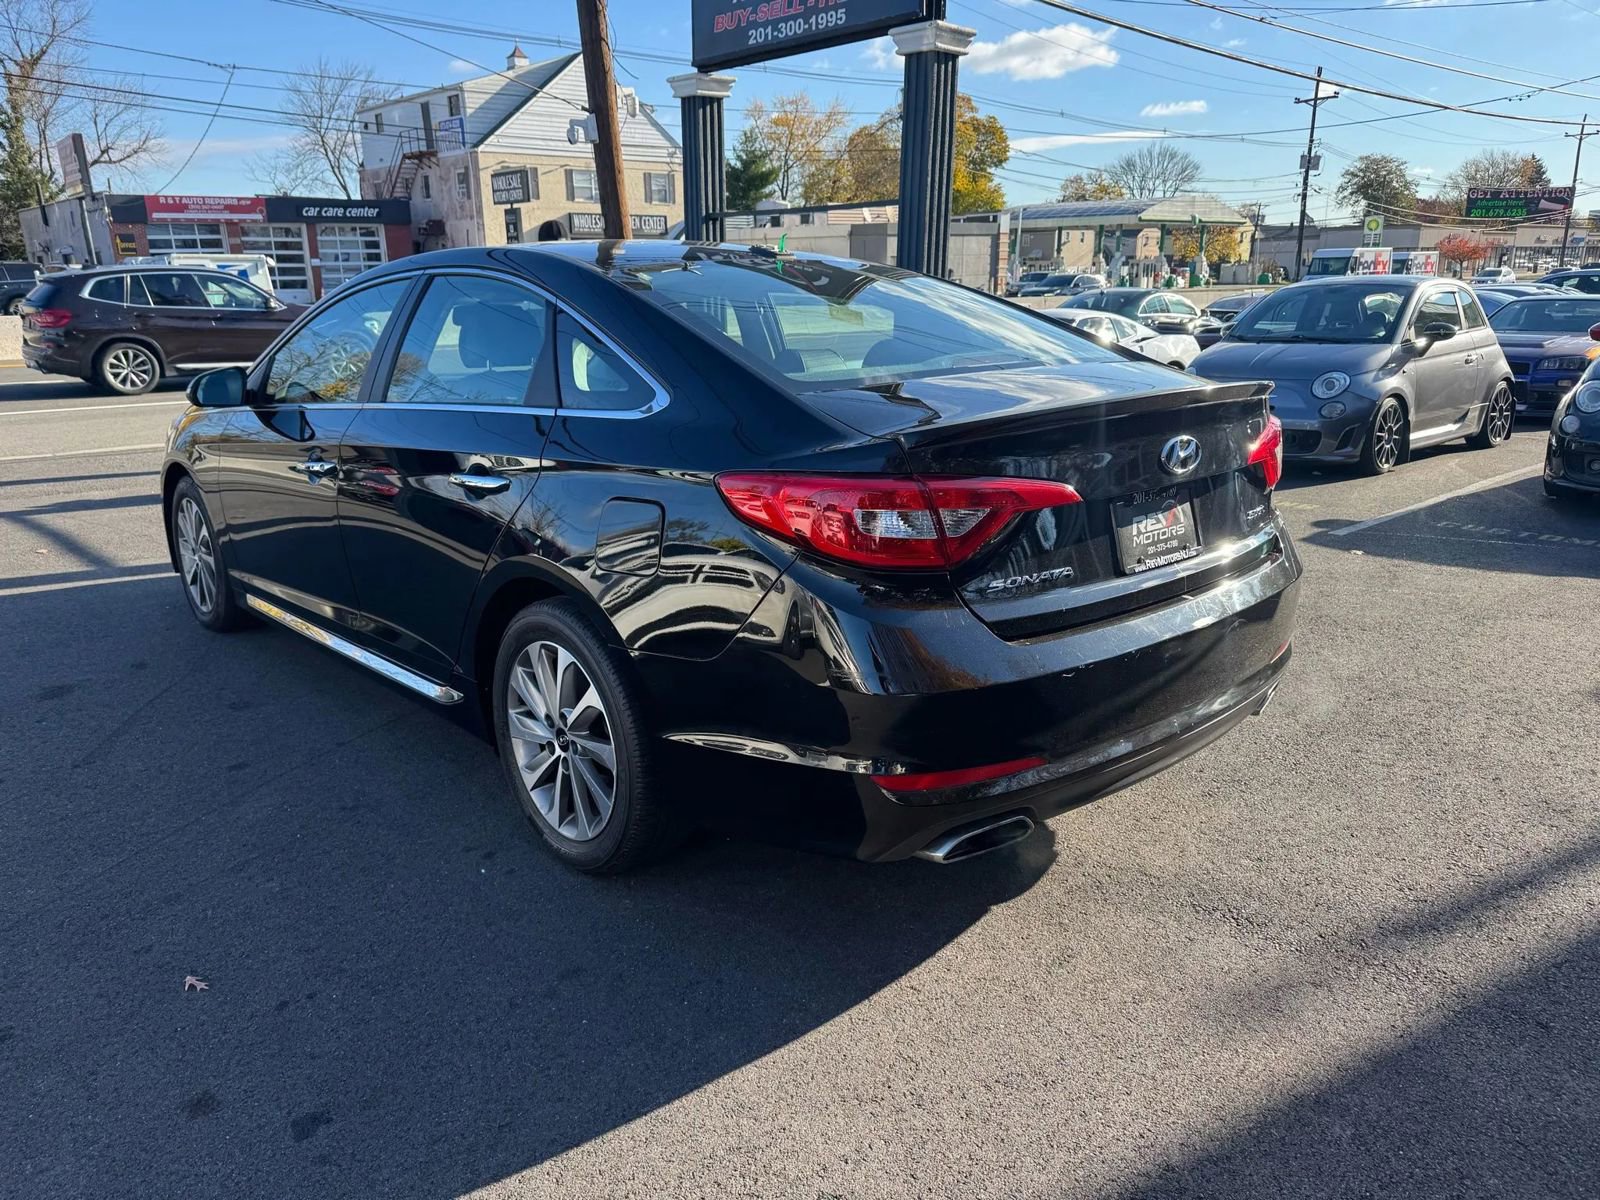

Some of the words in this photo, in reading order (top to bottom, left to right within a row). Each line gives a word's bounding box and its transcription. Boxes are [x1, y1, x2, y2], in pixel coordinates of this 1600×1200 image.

[748, 8, 847, 45] 201-300-1995
[492, 173, 522, 191] WHOLESALE
[509, 189, 524, 201] CENTER
[1469, 189, 1492, 199] GET
[1499, 187, 1572, 199] ATTENTION
[159, 196, 166, 204] R
[167, 196, 174, 204] &
[181, 197, 204, 205] AUTO
[205, 197, 239, 206] REPAIRS
[1476, 199, 1506, 208] Advertise
[302, 206, 320, 217] car
[321, 207, 345, 217] care
[345, 205, 380, 217] center
[1470, 208, 1528, 217] 201.679.6235
[641, 215, 666, 230] CENTER
[1132, 523, 1185, 547] MOTORS
[986, 566, 1074, 594] SONATA
